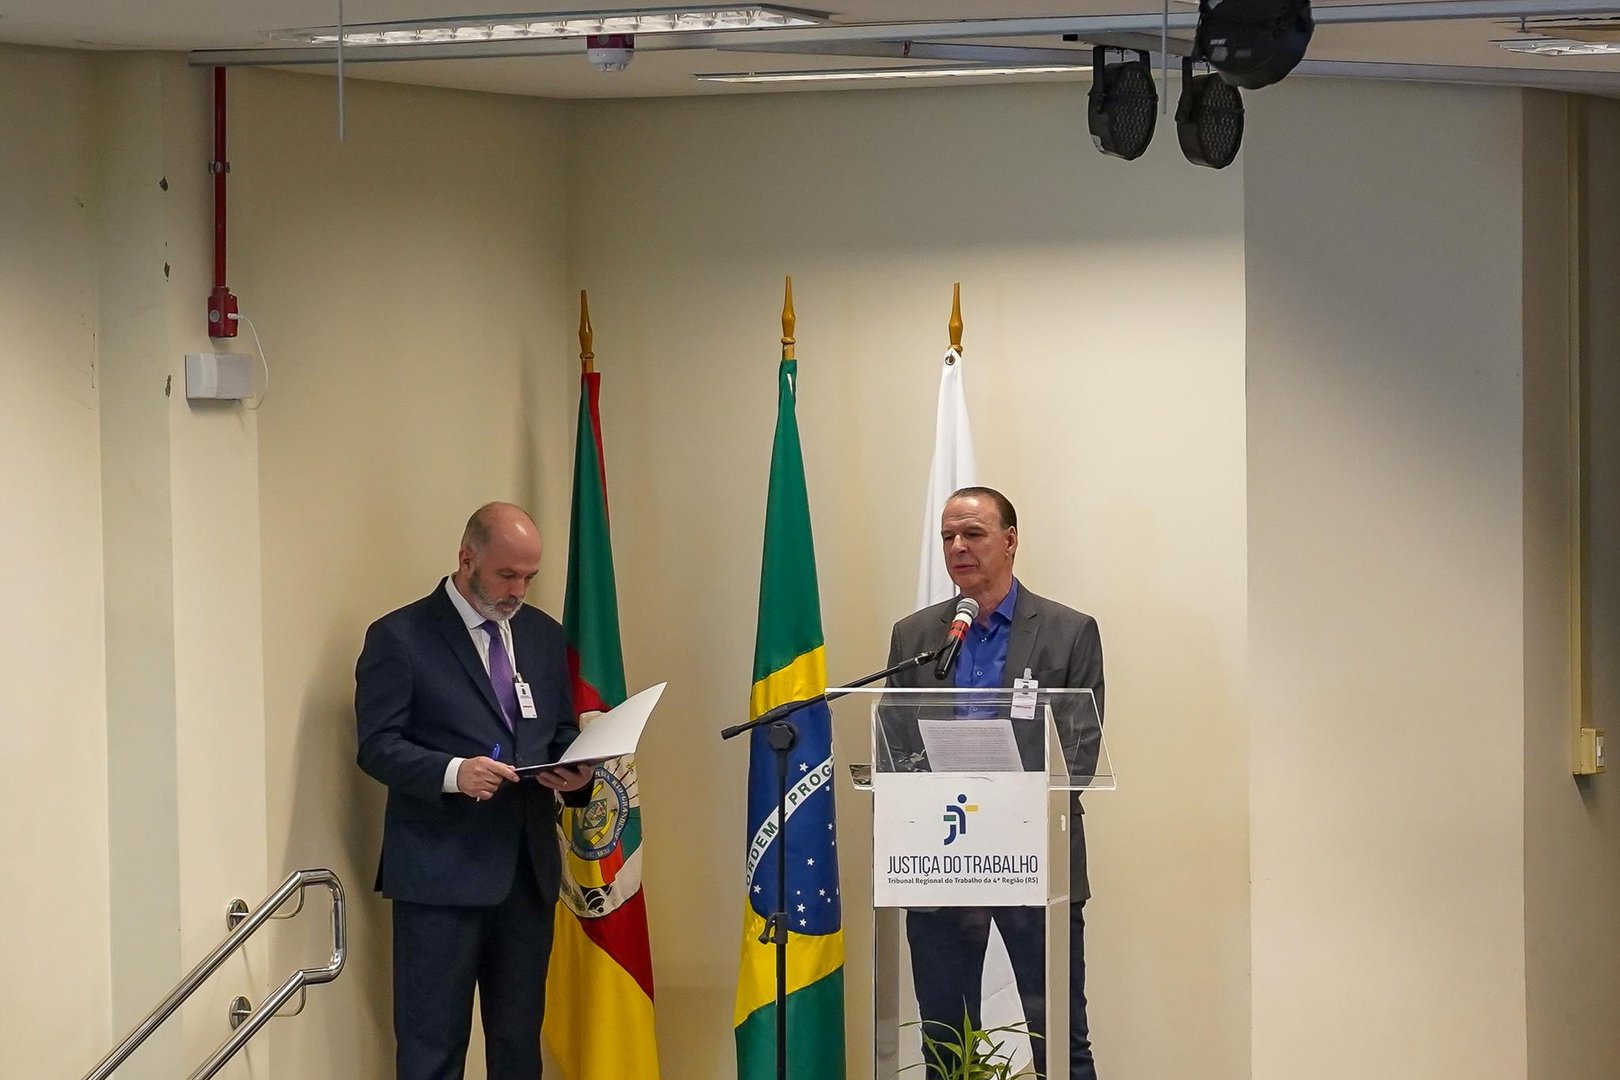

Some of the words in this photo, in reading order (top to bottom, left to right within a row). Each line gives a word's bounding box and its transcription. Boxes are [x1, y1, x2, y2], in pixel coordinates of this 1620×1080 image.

[746, 821, 778, 886] ORDEM
[788, 757, 834, 806] PROG
[887, 855, 941, 877] JUSTIÇA
[943, 855, 961, 874] DO
[964, 855, 1038, 874] TRABALHO
[915, 877, 944, 885] Regional
[1002, 877, 1024, 885] Região
[1025, 877, 1039, 885] (RS)
